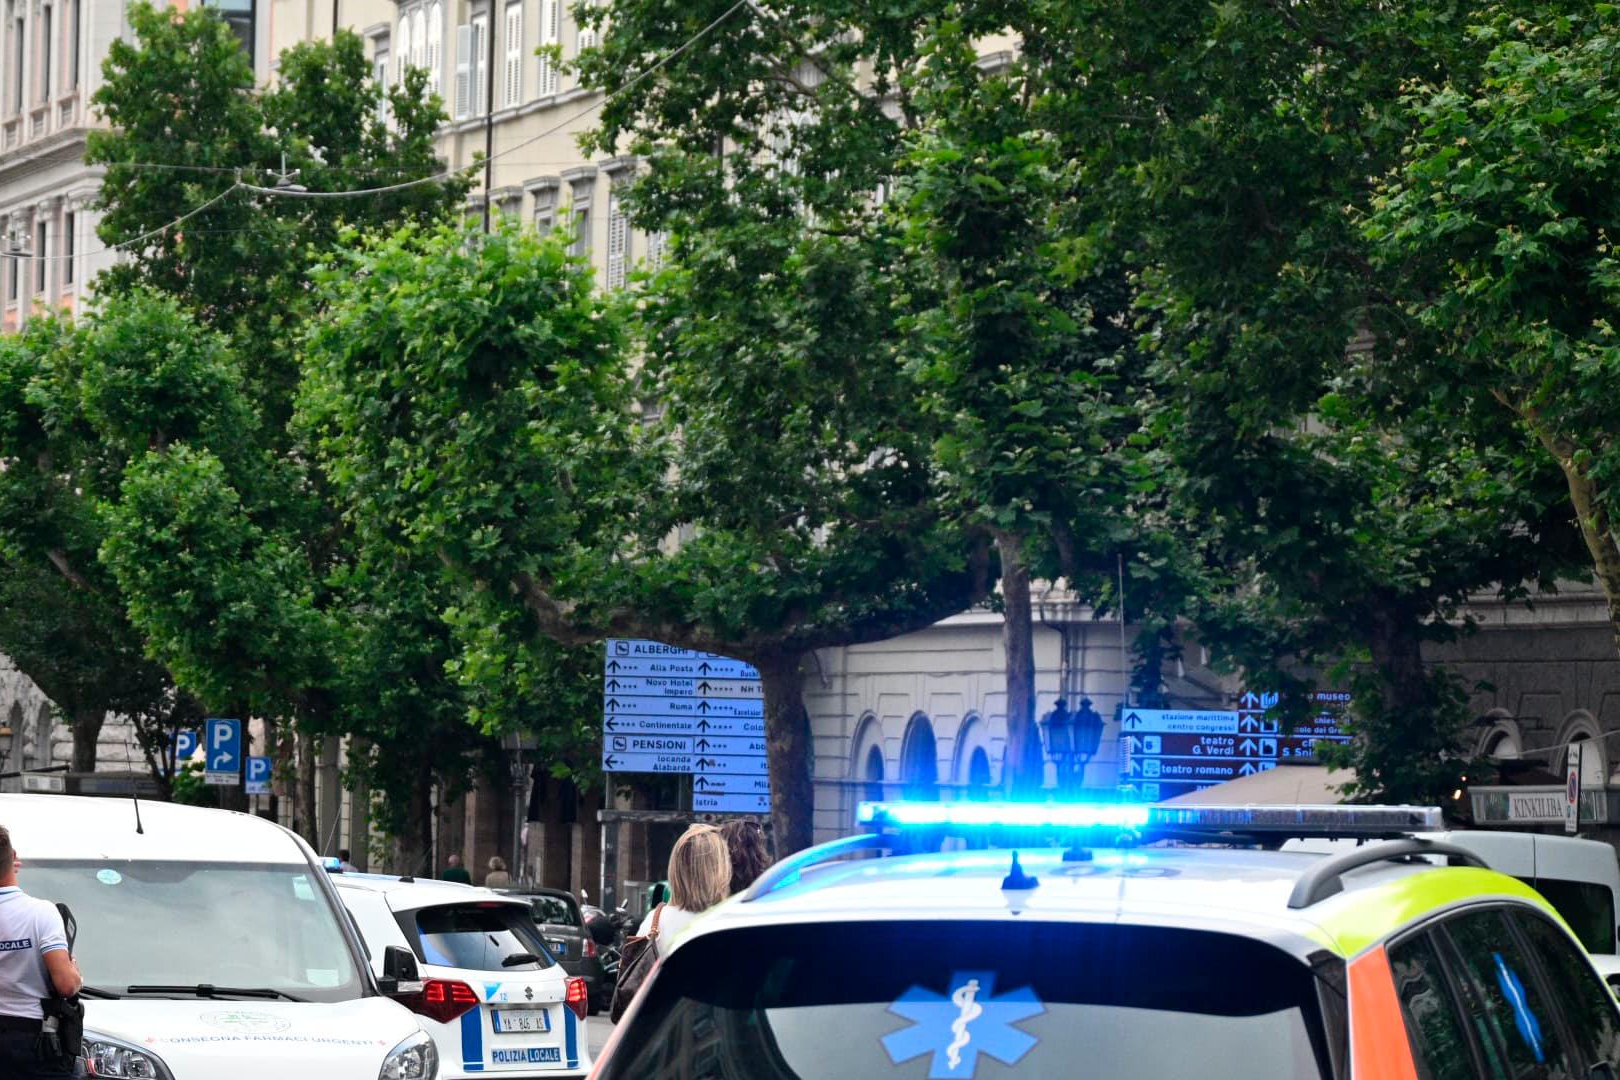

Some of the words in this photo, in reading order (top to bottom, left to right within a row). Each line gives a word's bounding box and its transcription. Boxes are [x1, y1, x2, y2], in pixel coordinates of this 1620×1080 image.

[670, 679, 693, 687] Hotel
[1316, 692, 1351, 701] museo
[639, 720, 693, 730] Continentale
[214, 724, 233, 749] P
[1201, 736, 1235, 745] teatro
[176, 734, 190, 757] P
[633, 740, 687, 751] PENSIONI
[1207, 746, 1235, 755] Verdi
[250, 759, 266, 780] P
[1162, 764, 1193, 774] teatro
[1195, 766, 1234, 775] romano
[1514, 797, 1564, 817] KINKILIBA
[492, 1050, 527, 1062] POLIZIA
[529, 1049, 559, 1061] LOCALE
